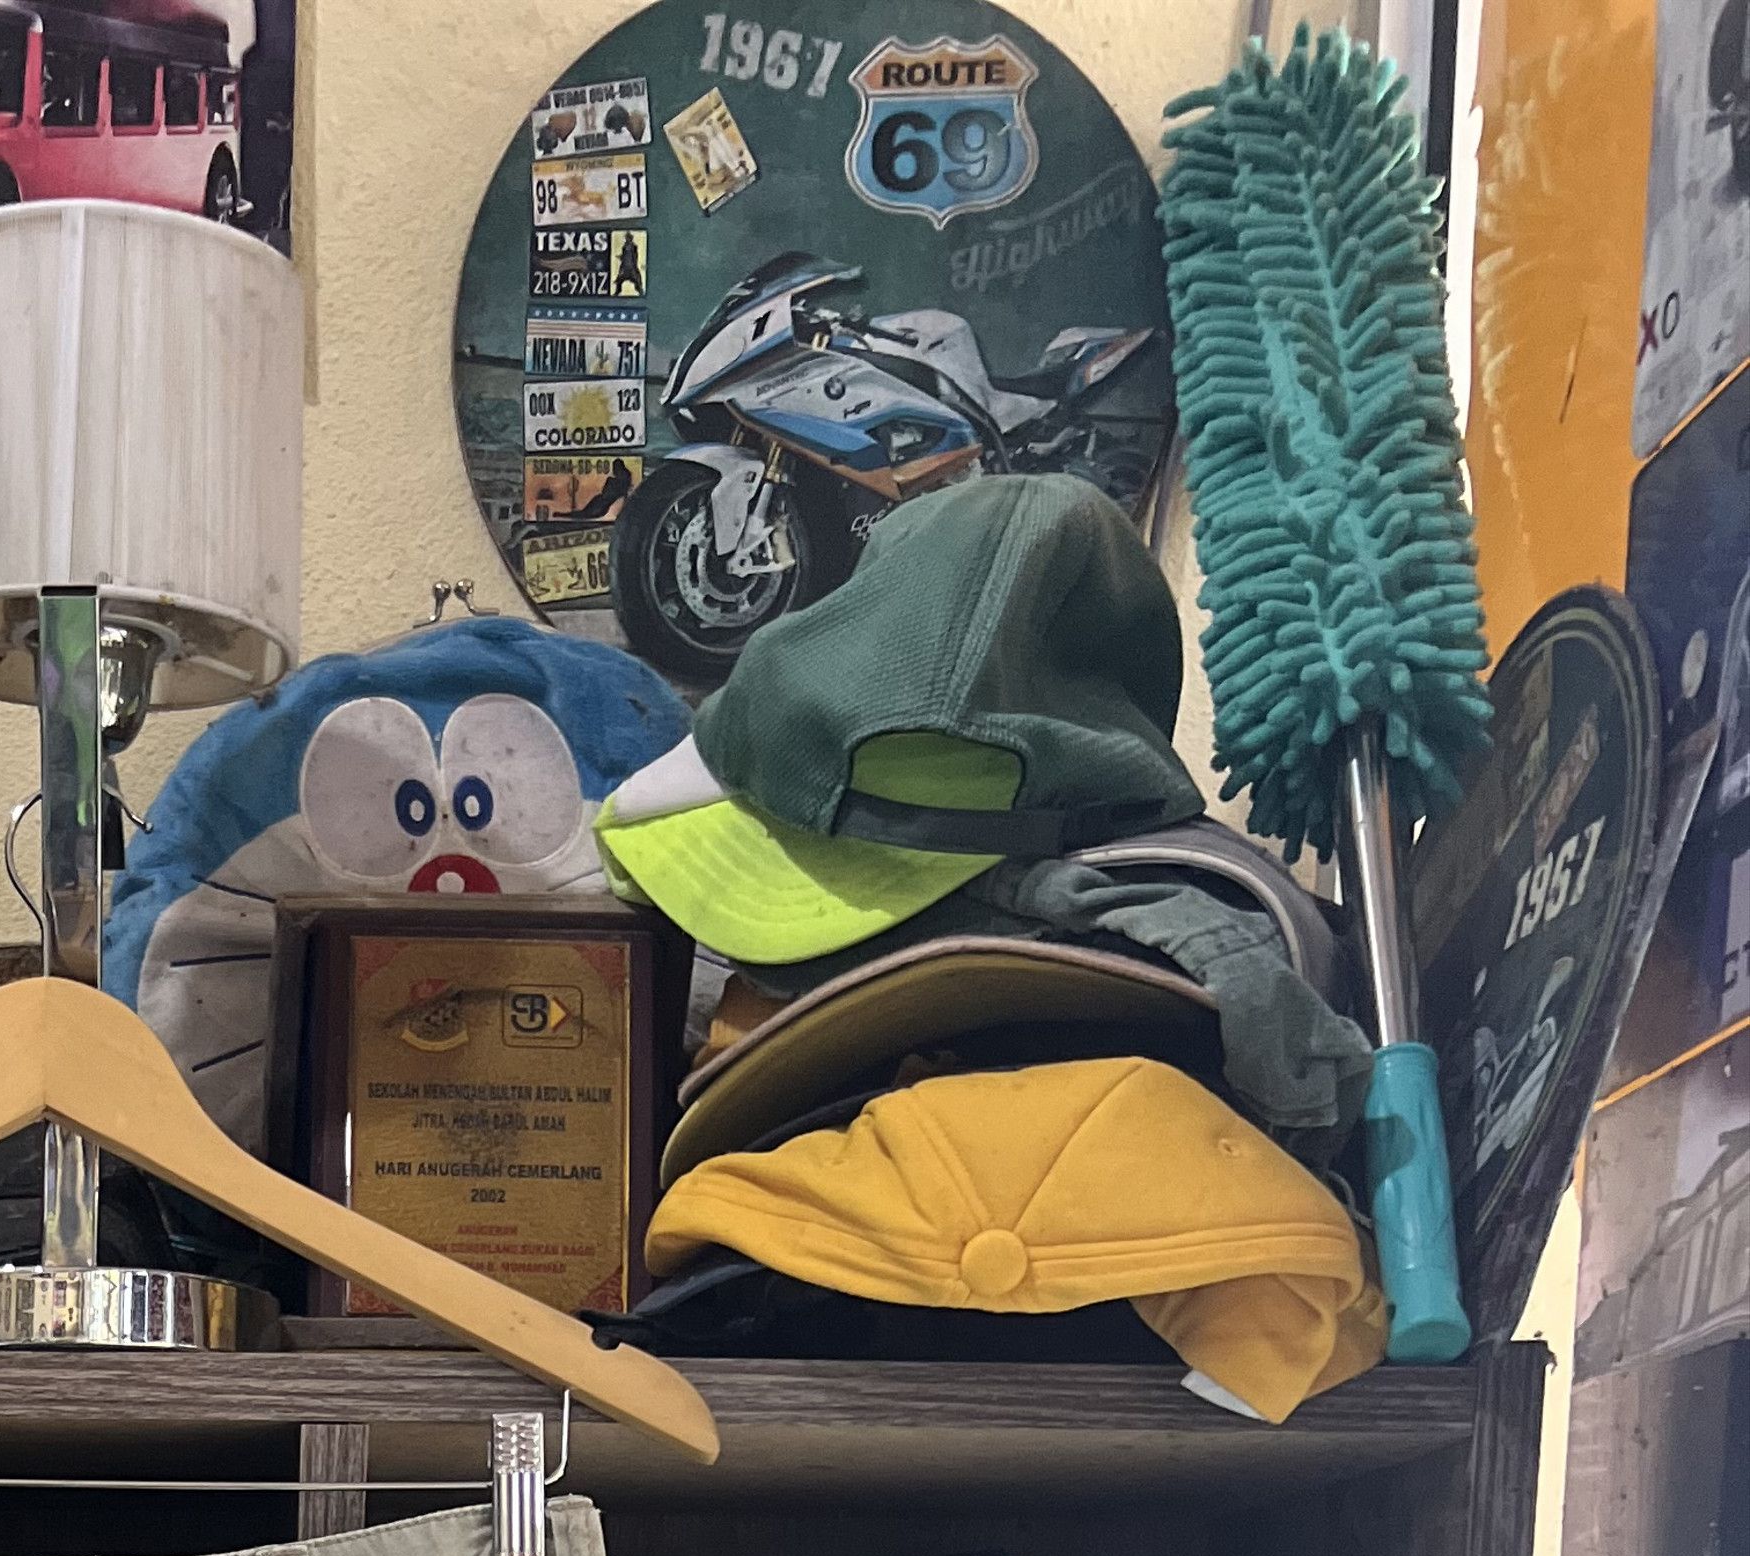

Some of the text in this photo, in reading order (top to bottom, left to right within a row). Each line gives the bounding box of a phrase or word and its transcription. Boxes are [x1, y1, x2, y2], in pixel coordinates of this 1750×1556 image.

[699, 12, 843, 98] 1967
[881, 58, 1007, 89] ROUTE
[871, 108, 1013, 193] 69
[536, 171, 645, 215] 98 BT
[535, 231, 609, 252] TEXAS
[533, 337, 587, 373] NEVADA
[617, 388, 641, 412] 123
[534, 424, 636, 447] COLORADO
[1504, 815, 1606, 950] 1967
[374, 1160, 602, 1180] HARI ANUGERAH CEMERLANG
